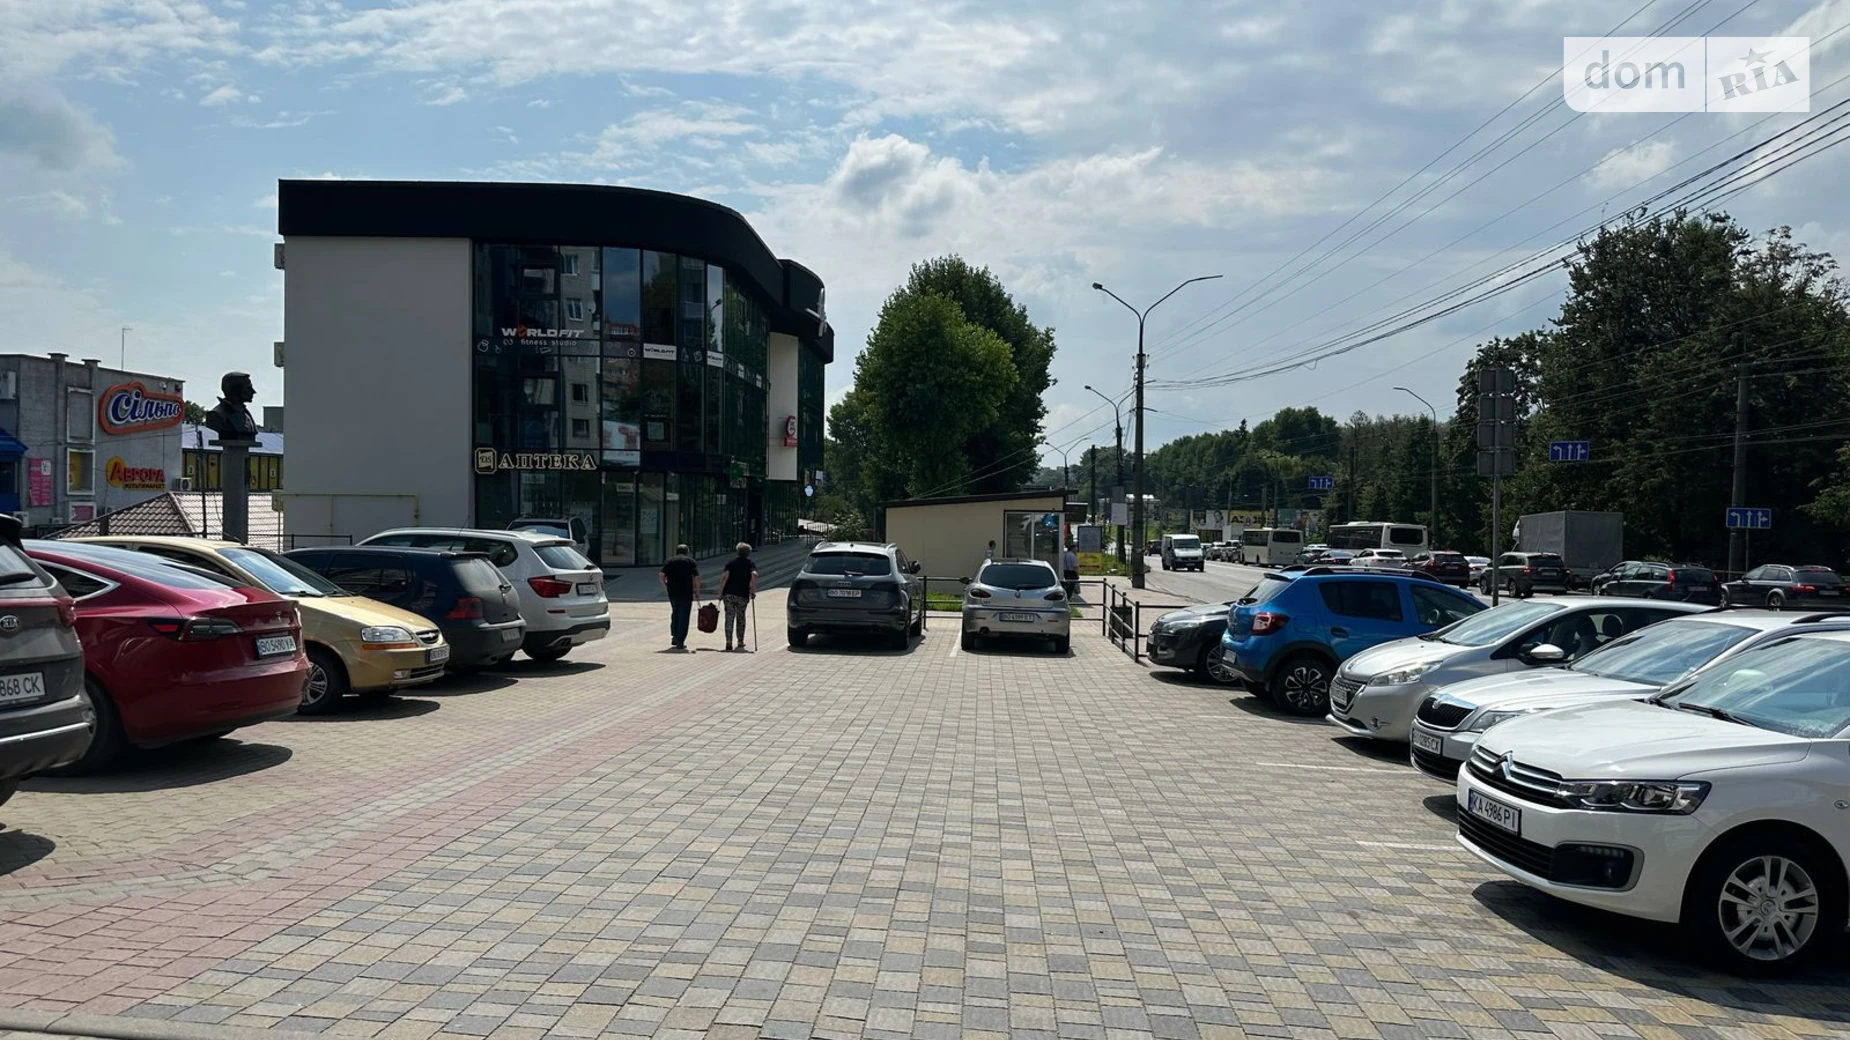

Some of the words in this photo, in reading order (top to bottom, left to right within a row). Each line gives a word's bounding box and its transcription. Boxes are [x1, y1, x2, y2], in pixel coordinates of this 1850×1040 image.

[110, 391, 181, 423] Сільпо
[498, 453, 597, 470] АПТЕКА
[2, 619, 18, 628] KIA
[23, 675, 41, 694] CK
[1471, 793, 1483, 814] KA
[1485, 801, 1502, 822] 4986
[1504, 808, 1516, 829] PI
